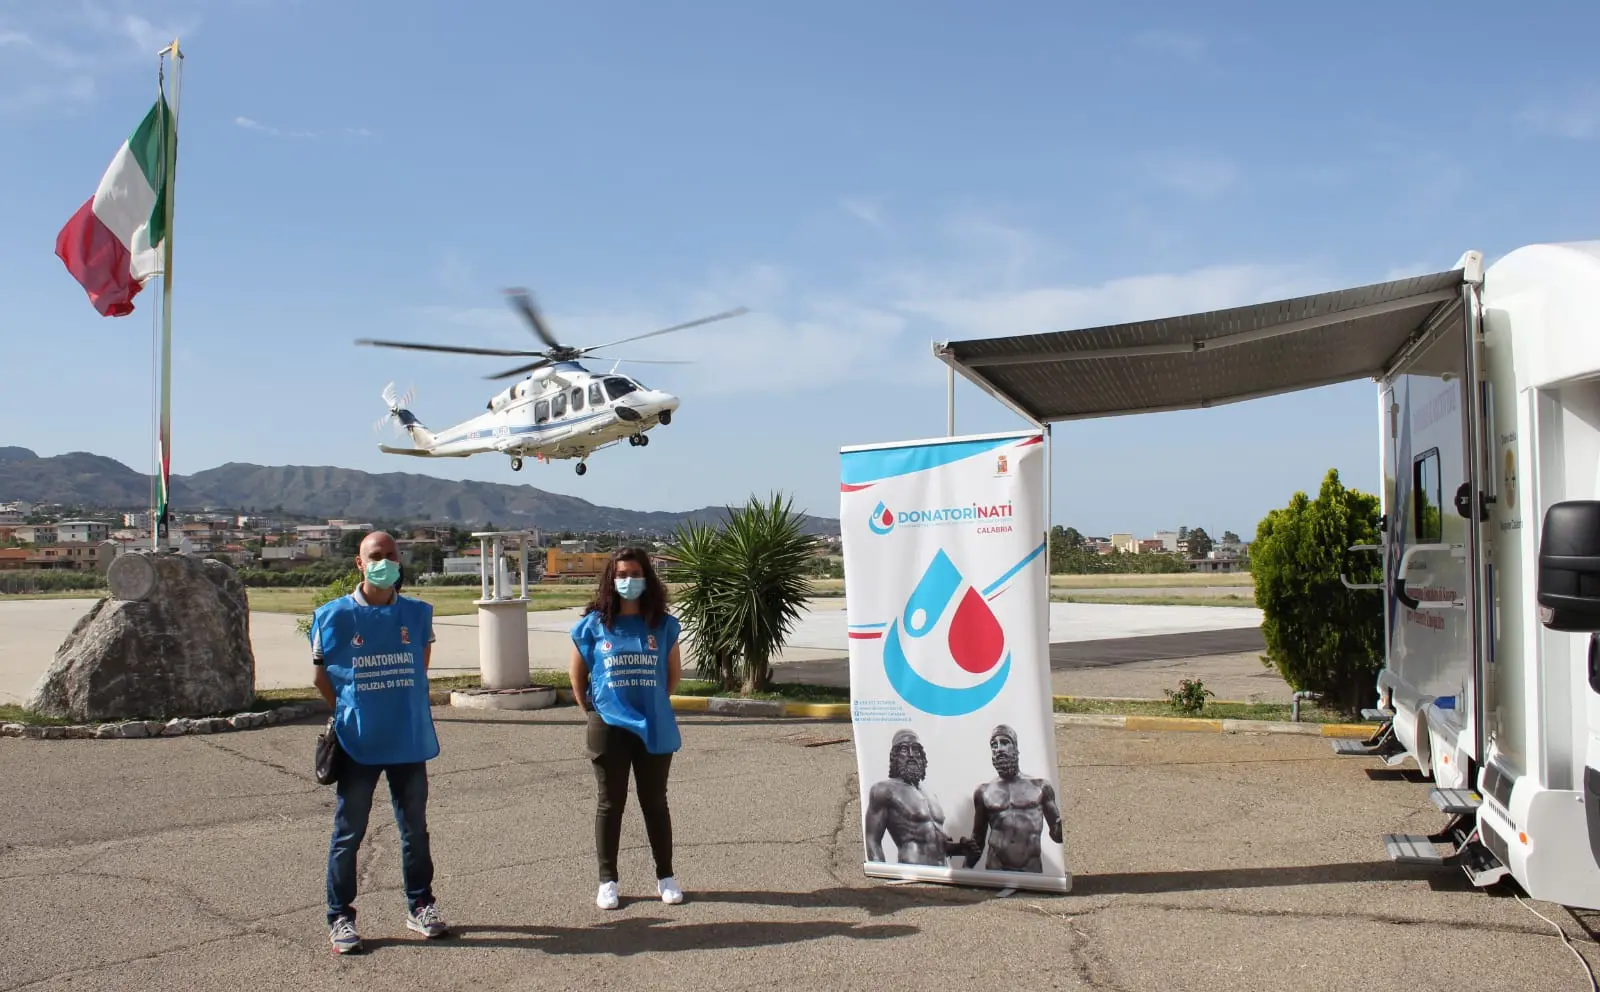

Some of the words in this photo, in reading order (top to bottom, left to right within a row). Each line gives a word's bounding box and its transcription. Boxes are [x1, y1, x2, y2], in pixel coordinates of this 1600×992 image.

[977, 525, 1013, 534] CALABRIA
[357, 681, 385, 692] POLIZIA
[387, 680, 395, 688] DI
